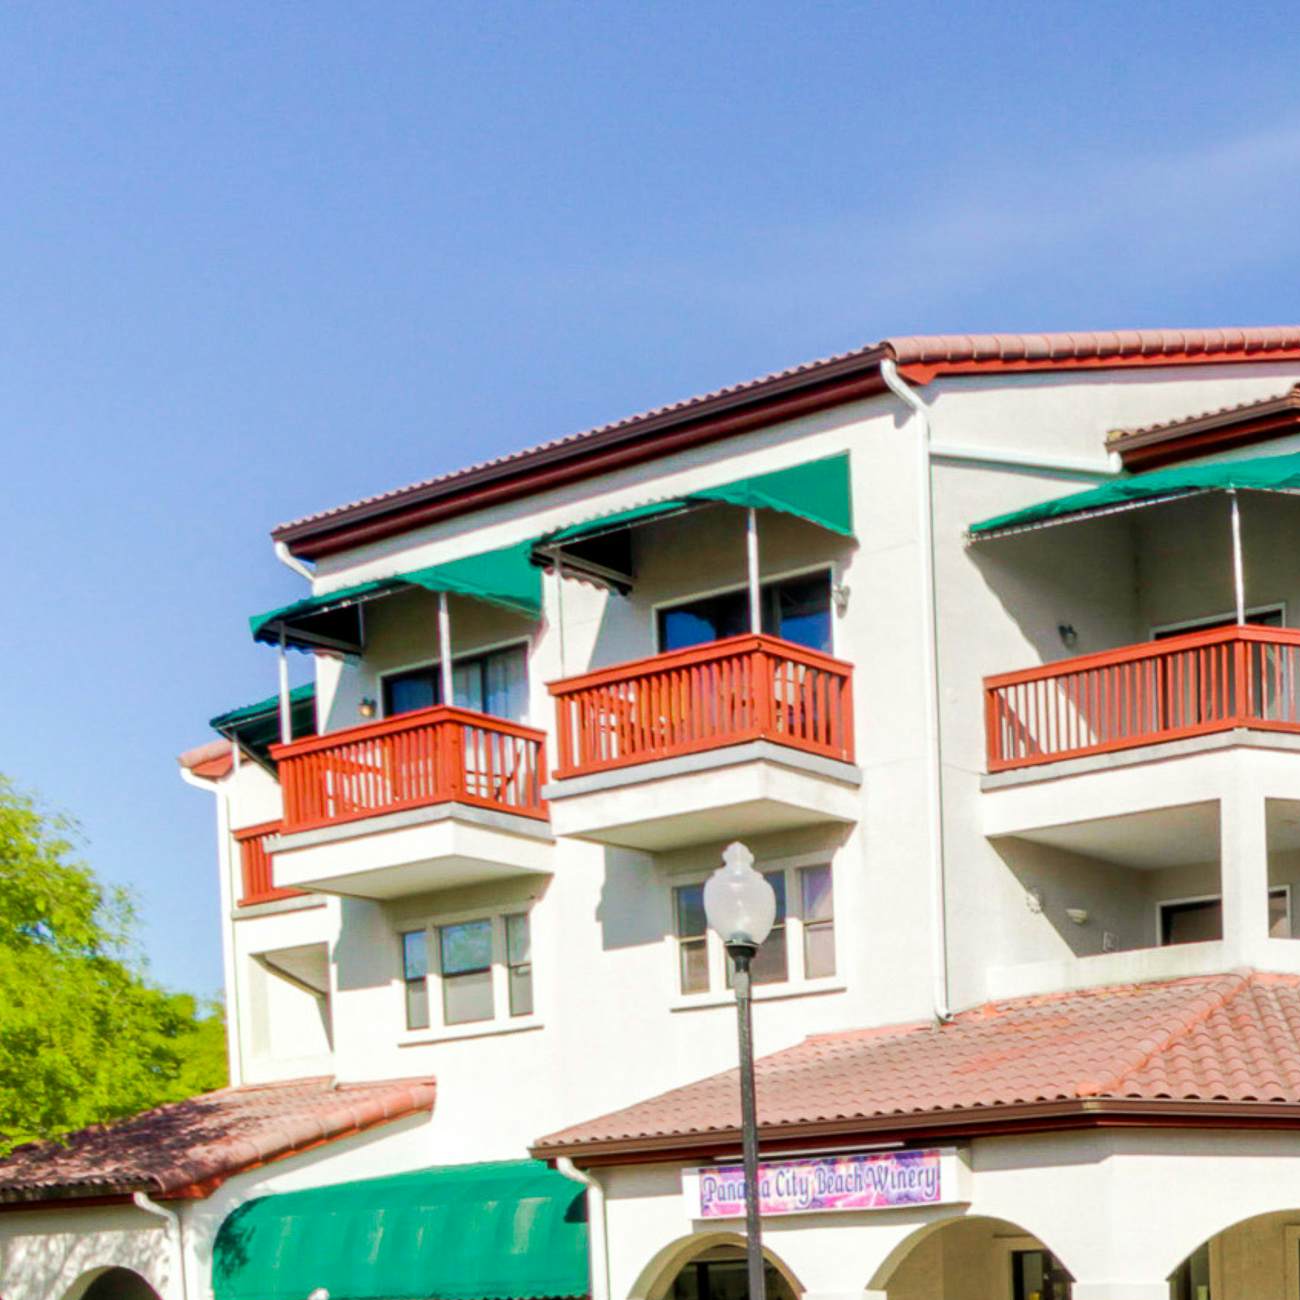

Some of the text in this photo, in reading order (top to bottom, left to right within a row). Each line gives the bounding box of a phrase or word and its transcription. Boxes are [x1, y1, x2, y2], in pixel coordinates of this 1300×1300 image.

[703, 1161, 937, 1204] Panaa City Beach Winery
